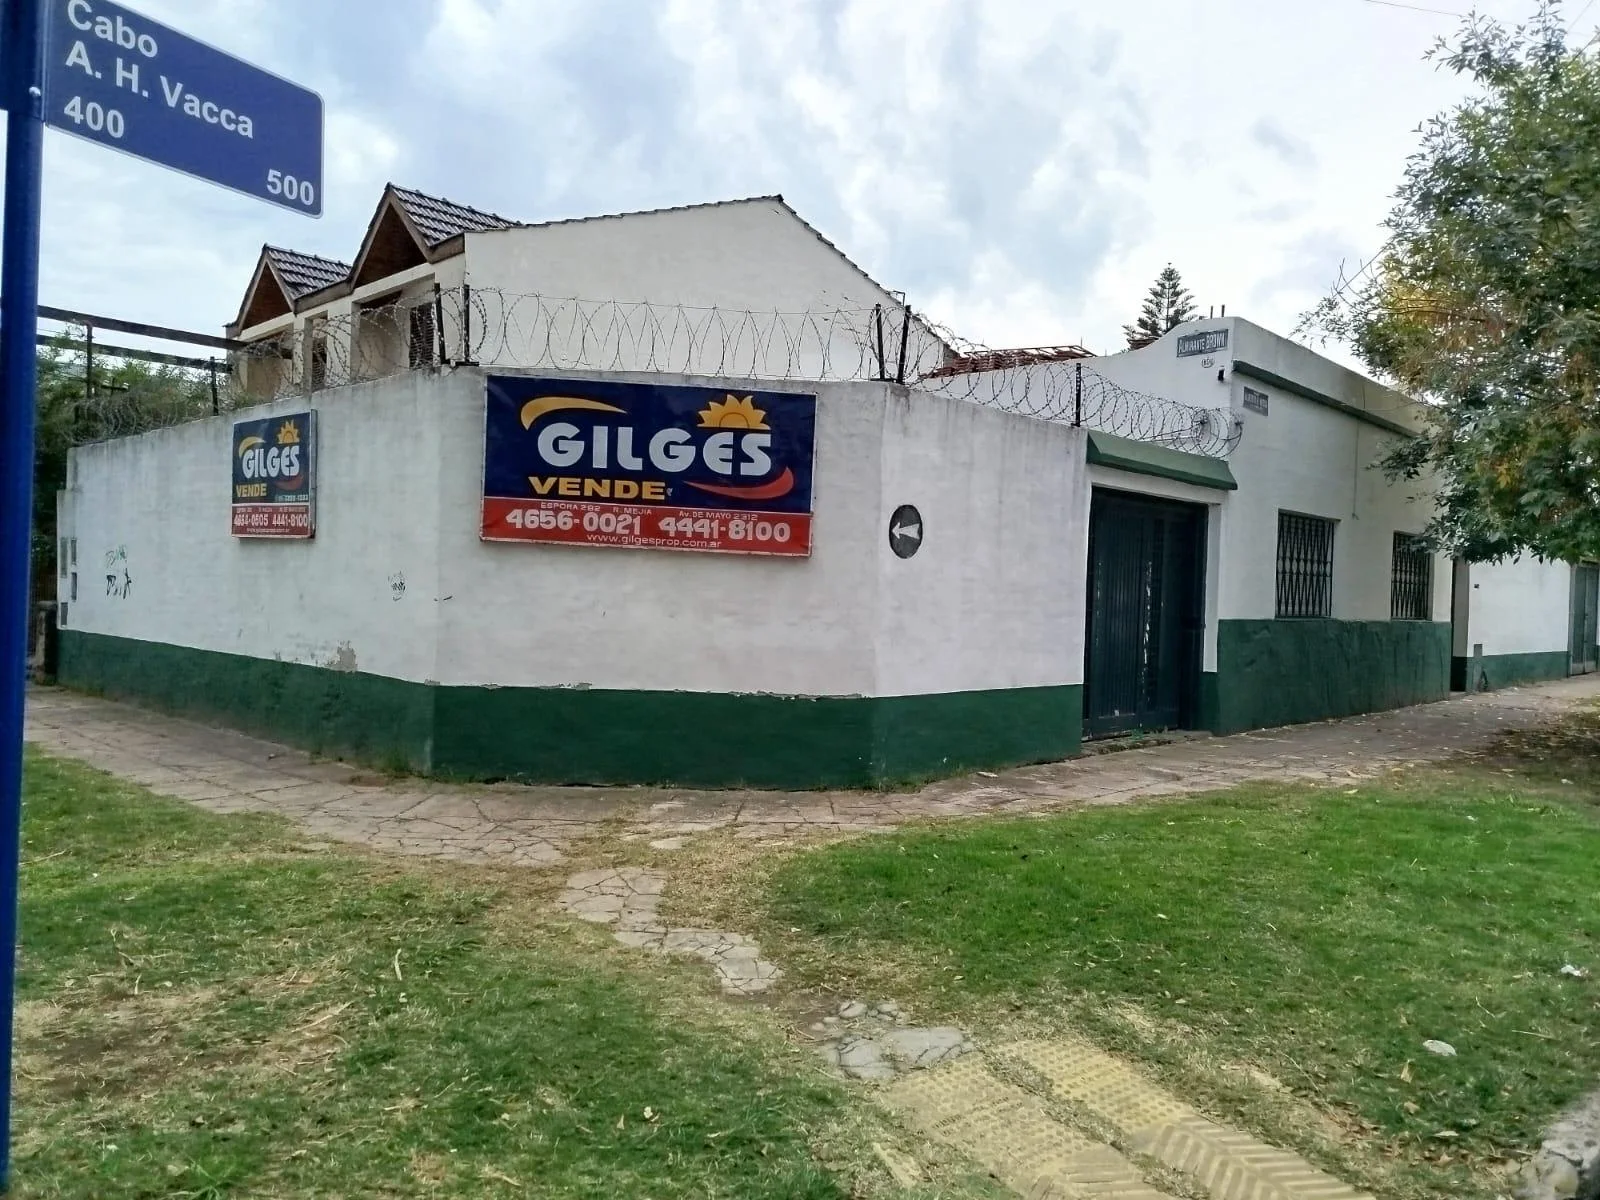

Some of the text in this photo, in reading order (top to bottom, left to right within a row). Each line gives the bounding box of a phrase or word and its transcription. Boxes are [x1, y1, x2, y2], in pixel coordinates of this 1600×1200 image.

[67, 0, 158, 58] Cabo
[65, 40, 254, 139] A. H. Vacca
[63, 96, 125, 139] 400
[266, 168, 315, 206] 500
[242, 445, 300, 479] GILGES
[537, 422, 772, 476] GILGES
[236, 483, 268, 498] VENDE
[528, 476, 665, 501] VENDE
[541, 502, 578, 511] ESPORA
[581, 504, 601, 512] 282
[272, 513, 308, 528] 4441-8100
[505, 509, 641, 535] 4656-0021
[658, 517, 791, 543] 4441-8100
[587, 534, 722, 548] www.gilgesprop.com.ar
